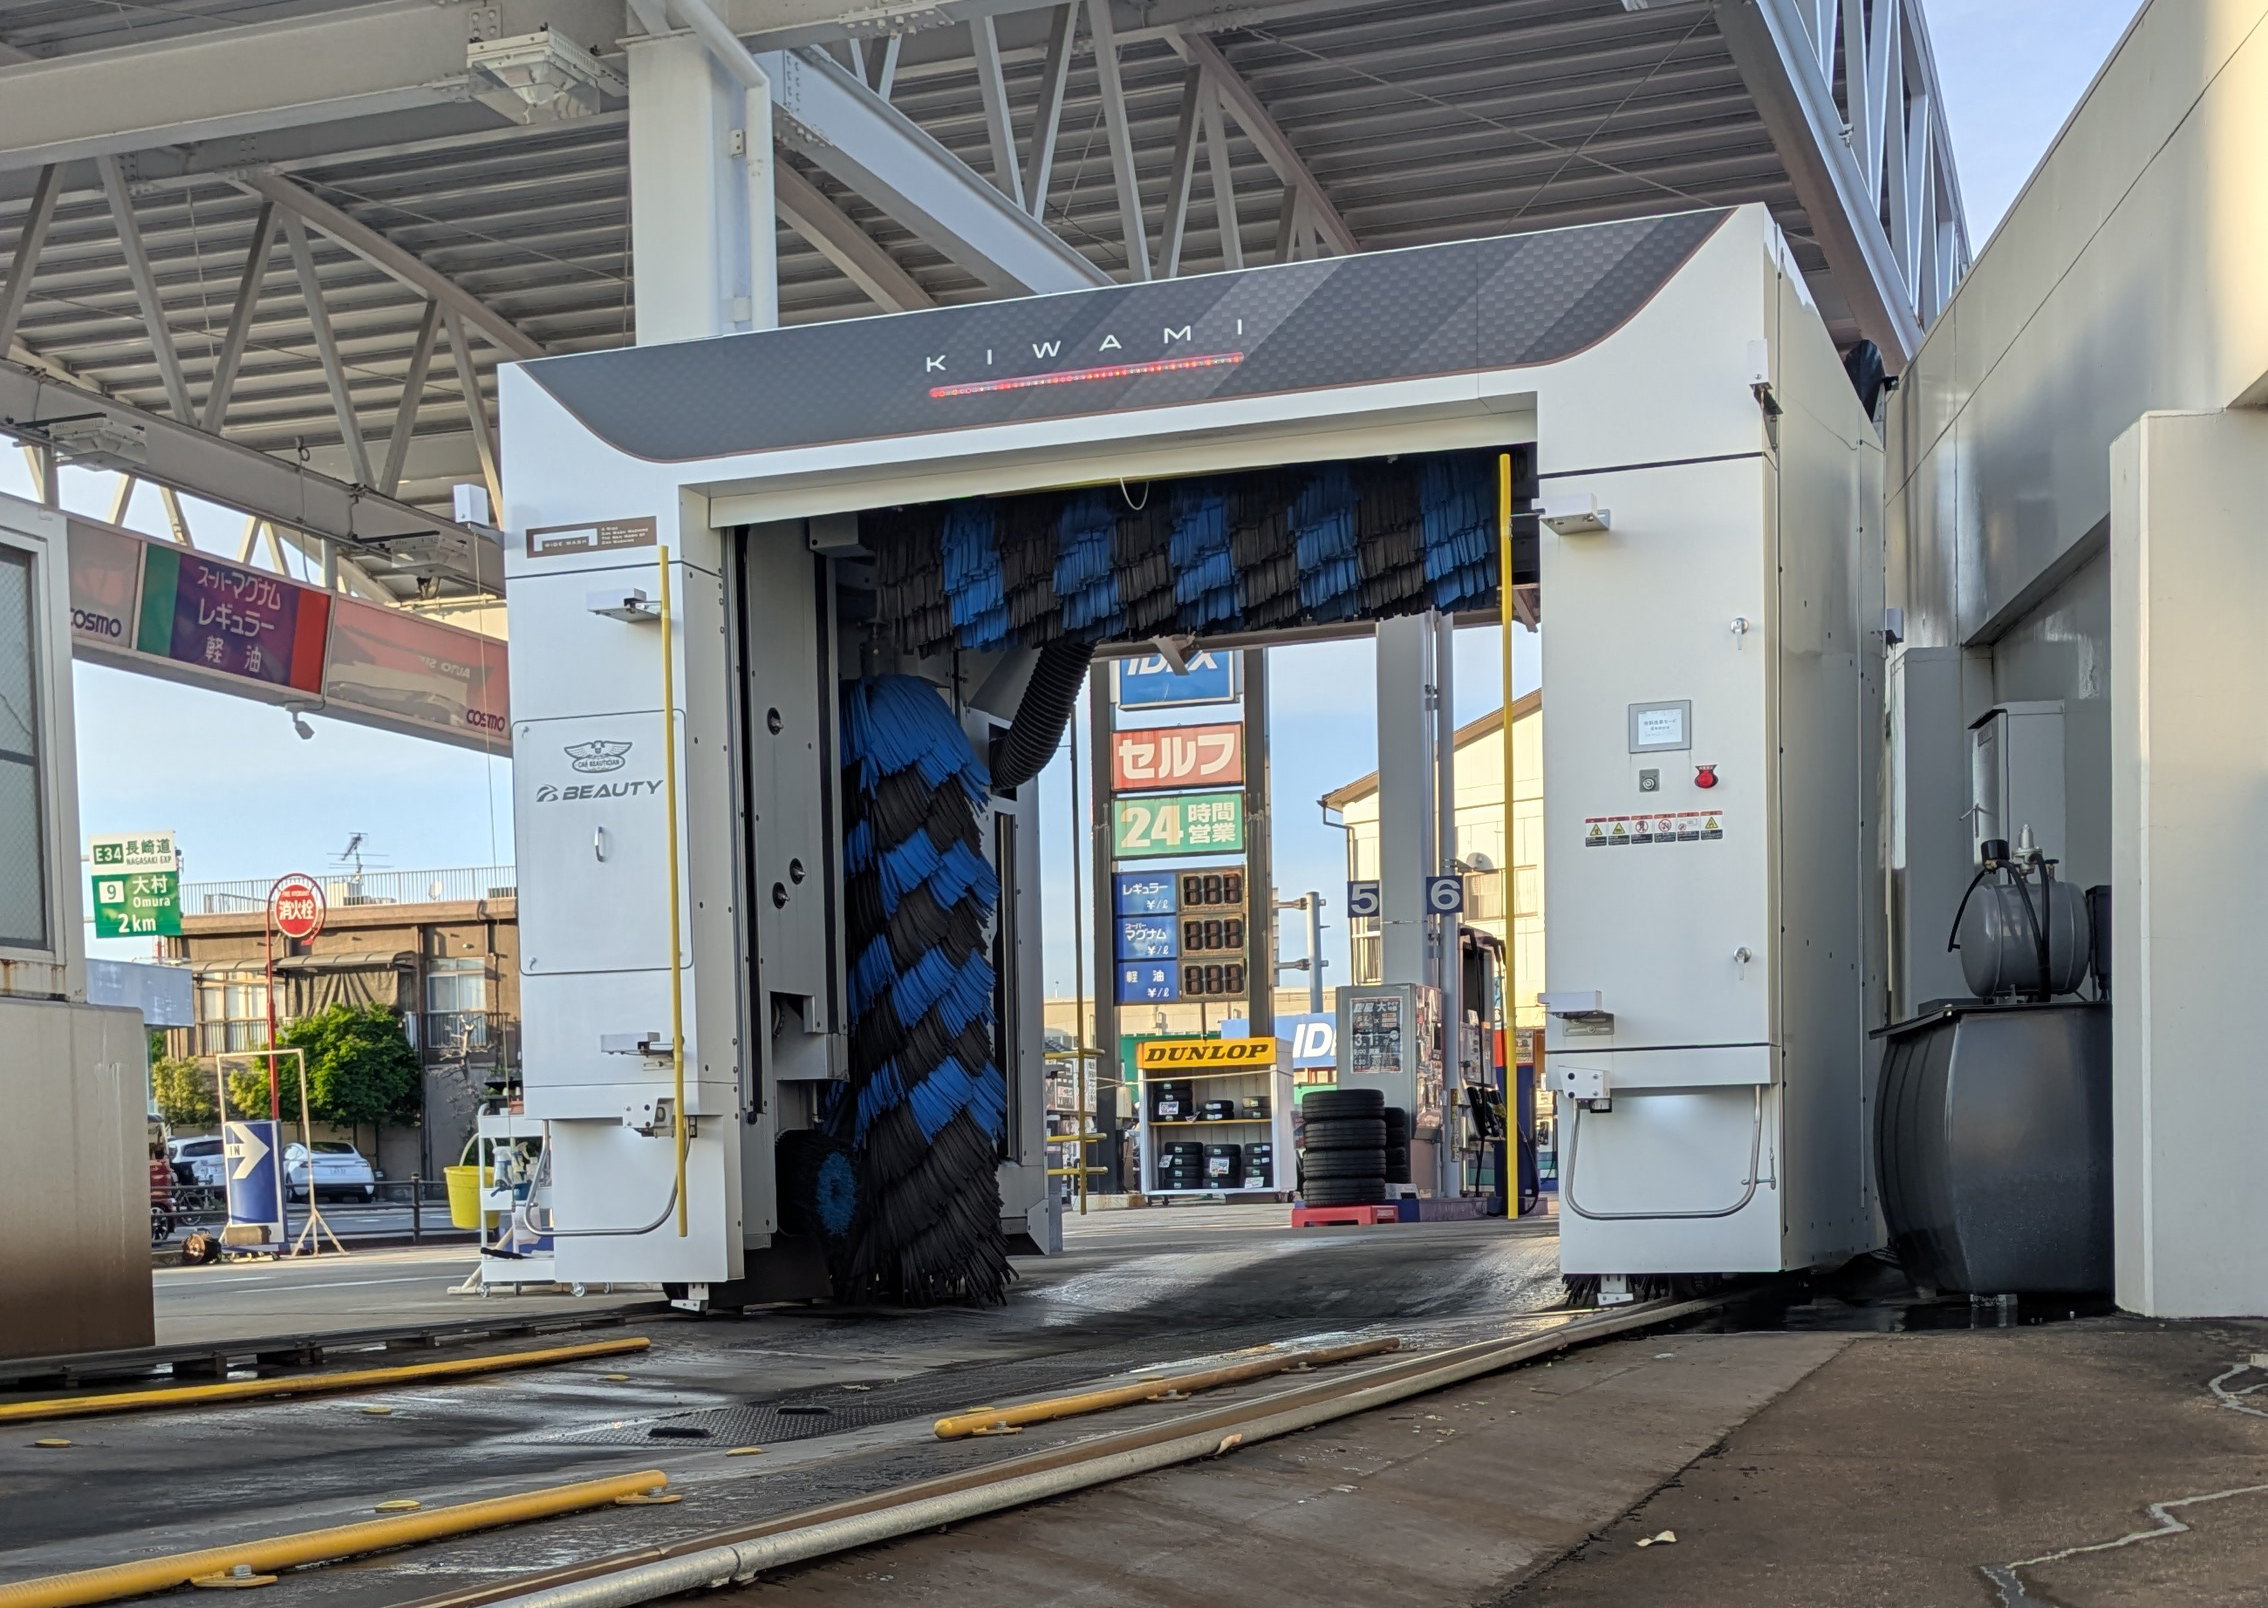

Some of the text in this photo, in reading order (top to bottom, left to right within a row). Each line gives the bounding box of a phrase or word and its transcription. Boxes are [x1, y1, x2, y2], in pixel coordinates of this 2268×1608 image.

[566, 538, 587, 546] WASH
[198, 598, 275, 637] レギュラー
[466, 709, 506, 732] COSMO
[1118, 733, 1235, 780] セルフ
[562, 780, 664, 800] BEAUTY
[1187, 802, 1235, 823] 時間
[1120, 804, 1184, 848] 24
[1188, 822, 1236, 844] 営業
[95, 846, 122, 862] E34
[126, 838, 171, 856] 長崎道
[126, 857, 158, 865] NAGASAKI
[106, 884, 117, 900] 9
[132, 874, 168, 894] 大村
[1123, 882, 1168, 895] レギュラー
[133, 896, 171, 908] Omura
[1351, 883, 1379, 914] 5
[1430, 879, 1461, 910] 6
[279, 899, 315, 920] 消火栓
[1125, 929, 1167, 941] マグナム
[1292, 1023, 1337, 1058] ID
[1145, 1044, 1269, 1062] DUNLOP
[230, 1144, 240, 1156] IN
